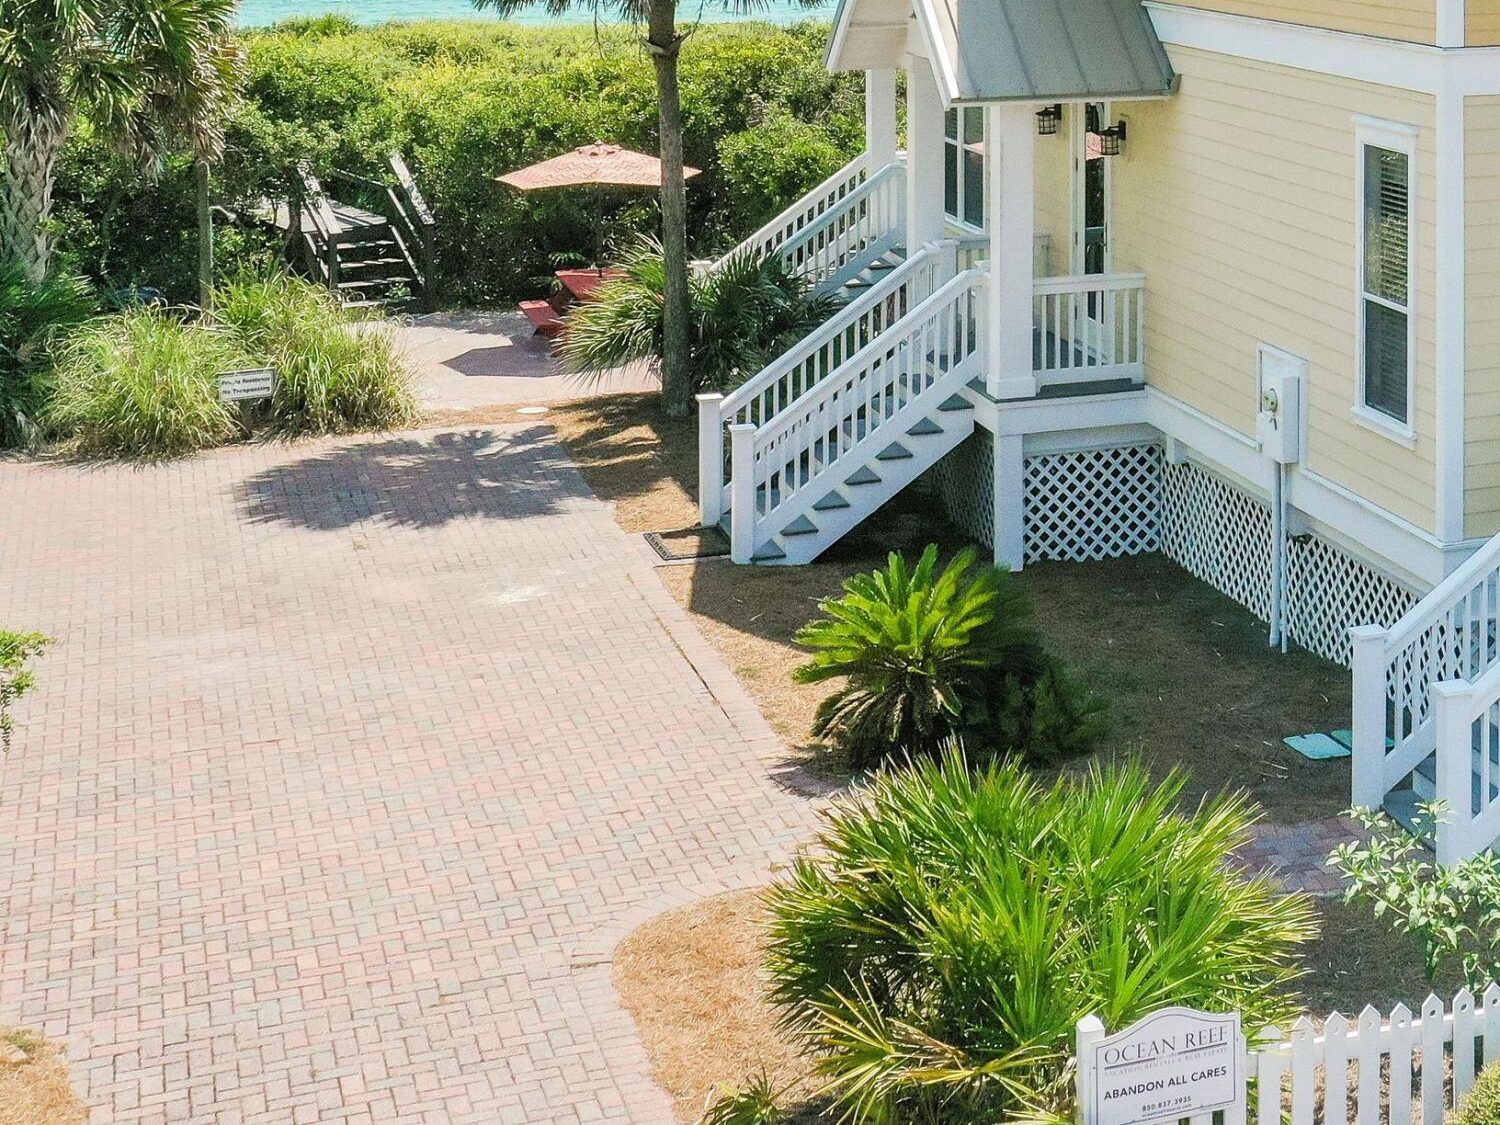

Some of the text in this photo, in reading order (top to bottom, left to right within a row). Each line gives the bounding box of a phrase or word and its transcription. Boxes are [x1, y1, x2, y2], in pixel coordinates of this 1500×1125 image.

[1104, 1025, 1227, 1064] OCEAN REEF
[1104, 1066, 1227, 1101] ABANDON ALL CARES
